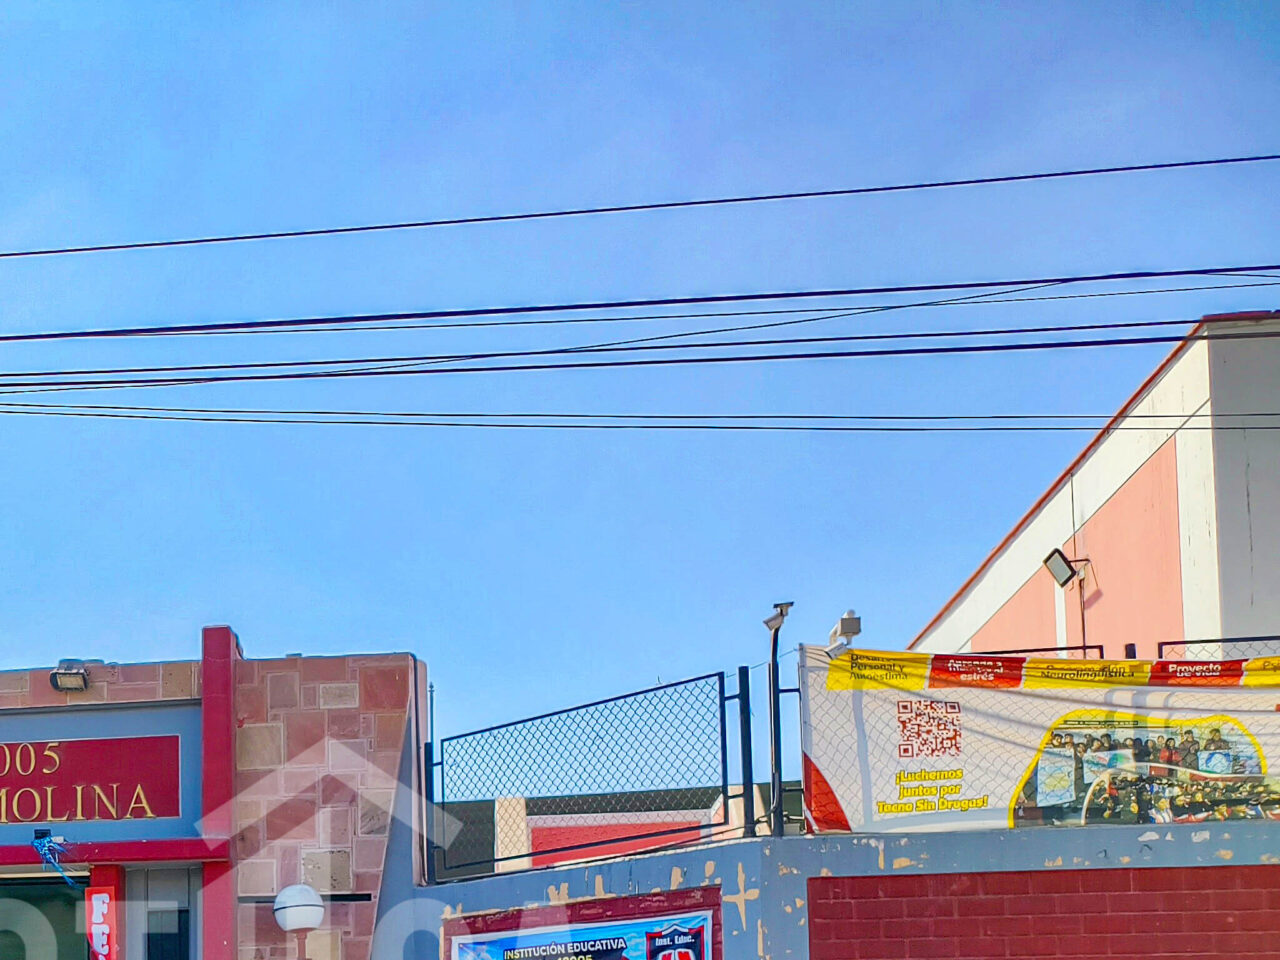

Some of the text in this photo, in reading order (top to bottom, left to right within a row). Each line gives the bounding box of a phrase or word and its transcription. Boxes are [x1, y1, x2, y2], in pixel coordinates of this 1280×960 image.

[899, 784, 962, 800] juntos por
[877, 800, 913, 813] Tacna
[915, 799, 936, 811] Sin
[504, 938, 627, 960] INSTITUCIÓN EDUCATIVA
